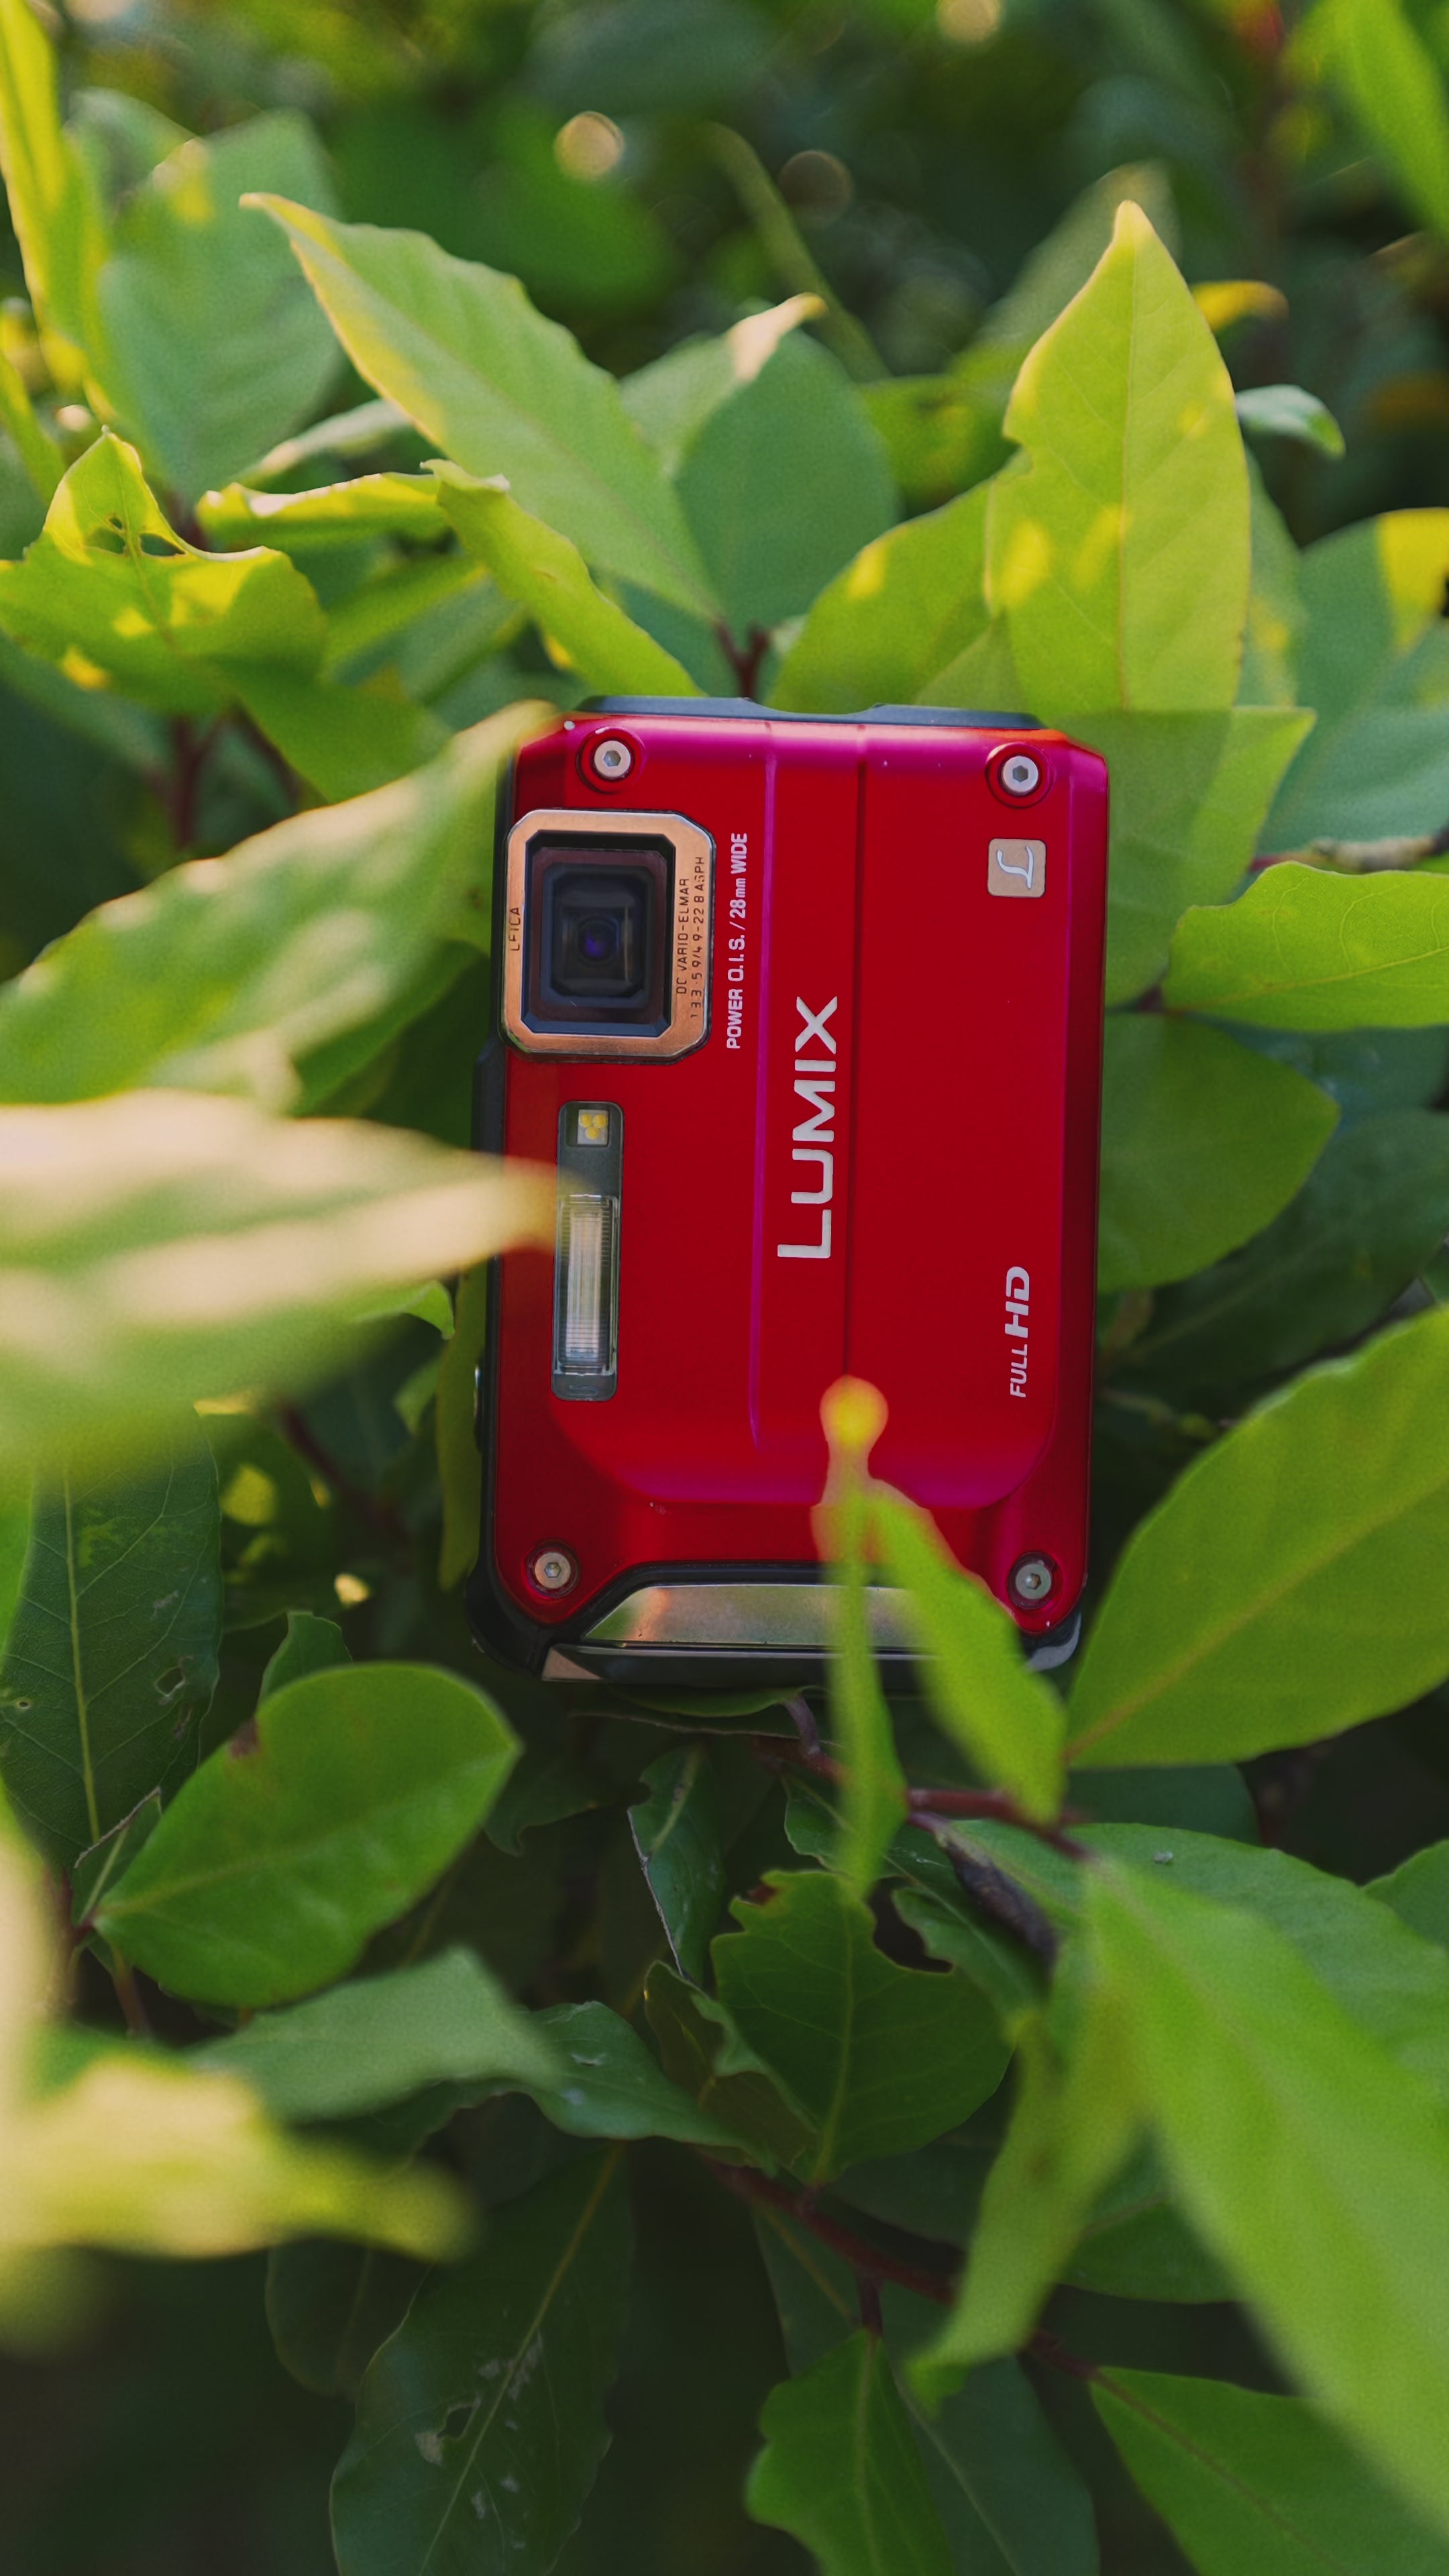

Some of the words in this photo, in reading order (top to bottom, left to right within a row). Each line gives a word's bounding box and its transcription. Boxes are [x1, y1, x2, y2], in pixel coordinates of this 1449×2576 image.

[730, 832, 748, 875] WIDE
[677, 878, 690, 971] VARIO-ELMAR
[729, 877, 747, 919] 28mm
[676, 977, 688, 994] DC
[727, 934, 745, 982] O.I.S.
[727, 988, 743, 1049] POWER
[777, 996, 838, 1259] LUMIX
[1005, 1266, 1030, 1338] HD
[1010, 1344, 1028, 1399] FULL
